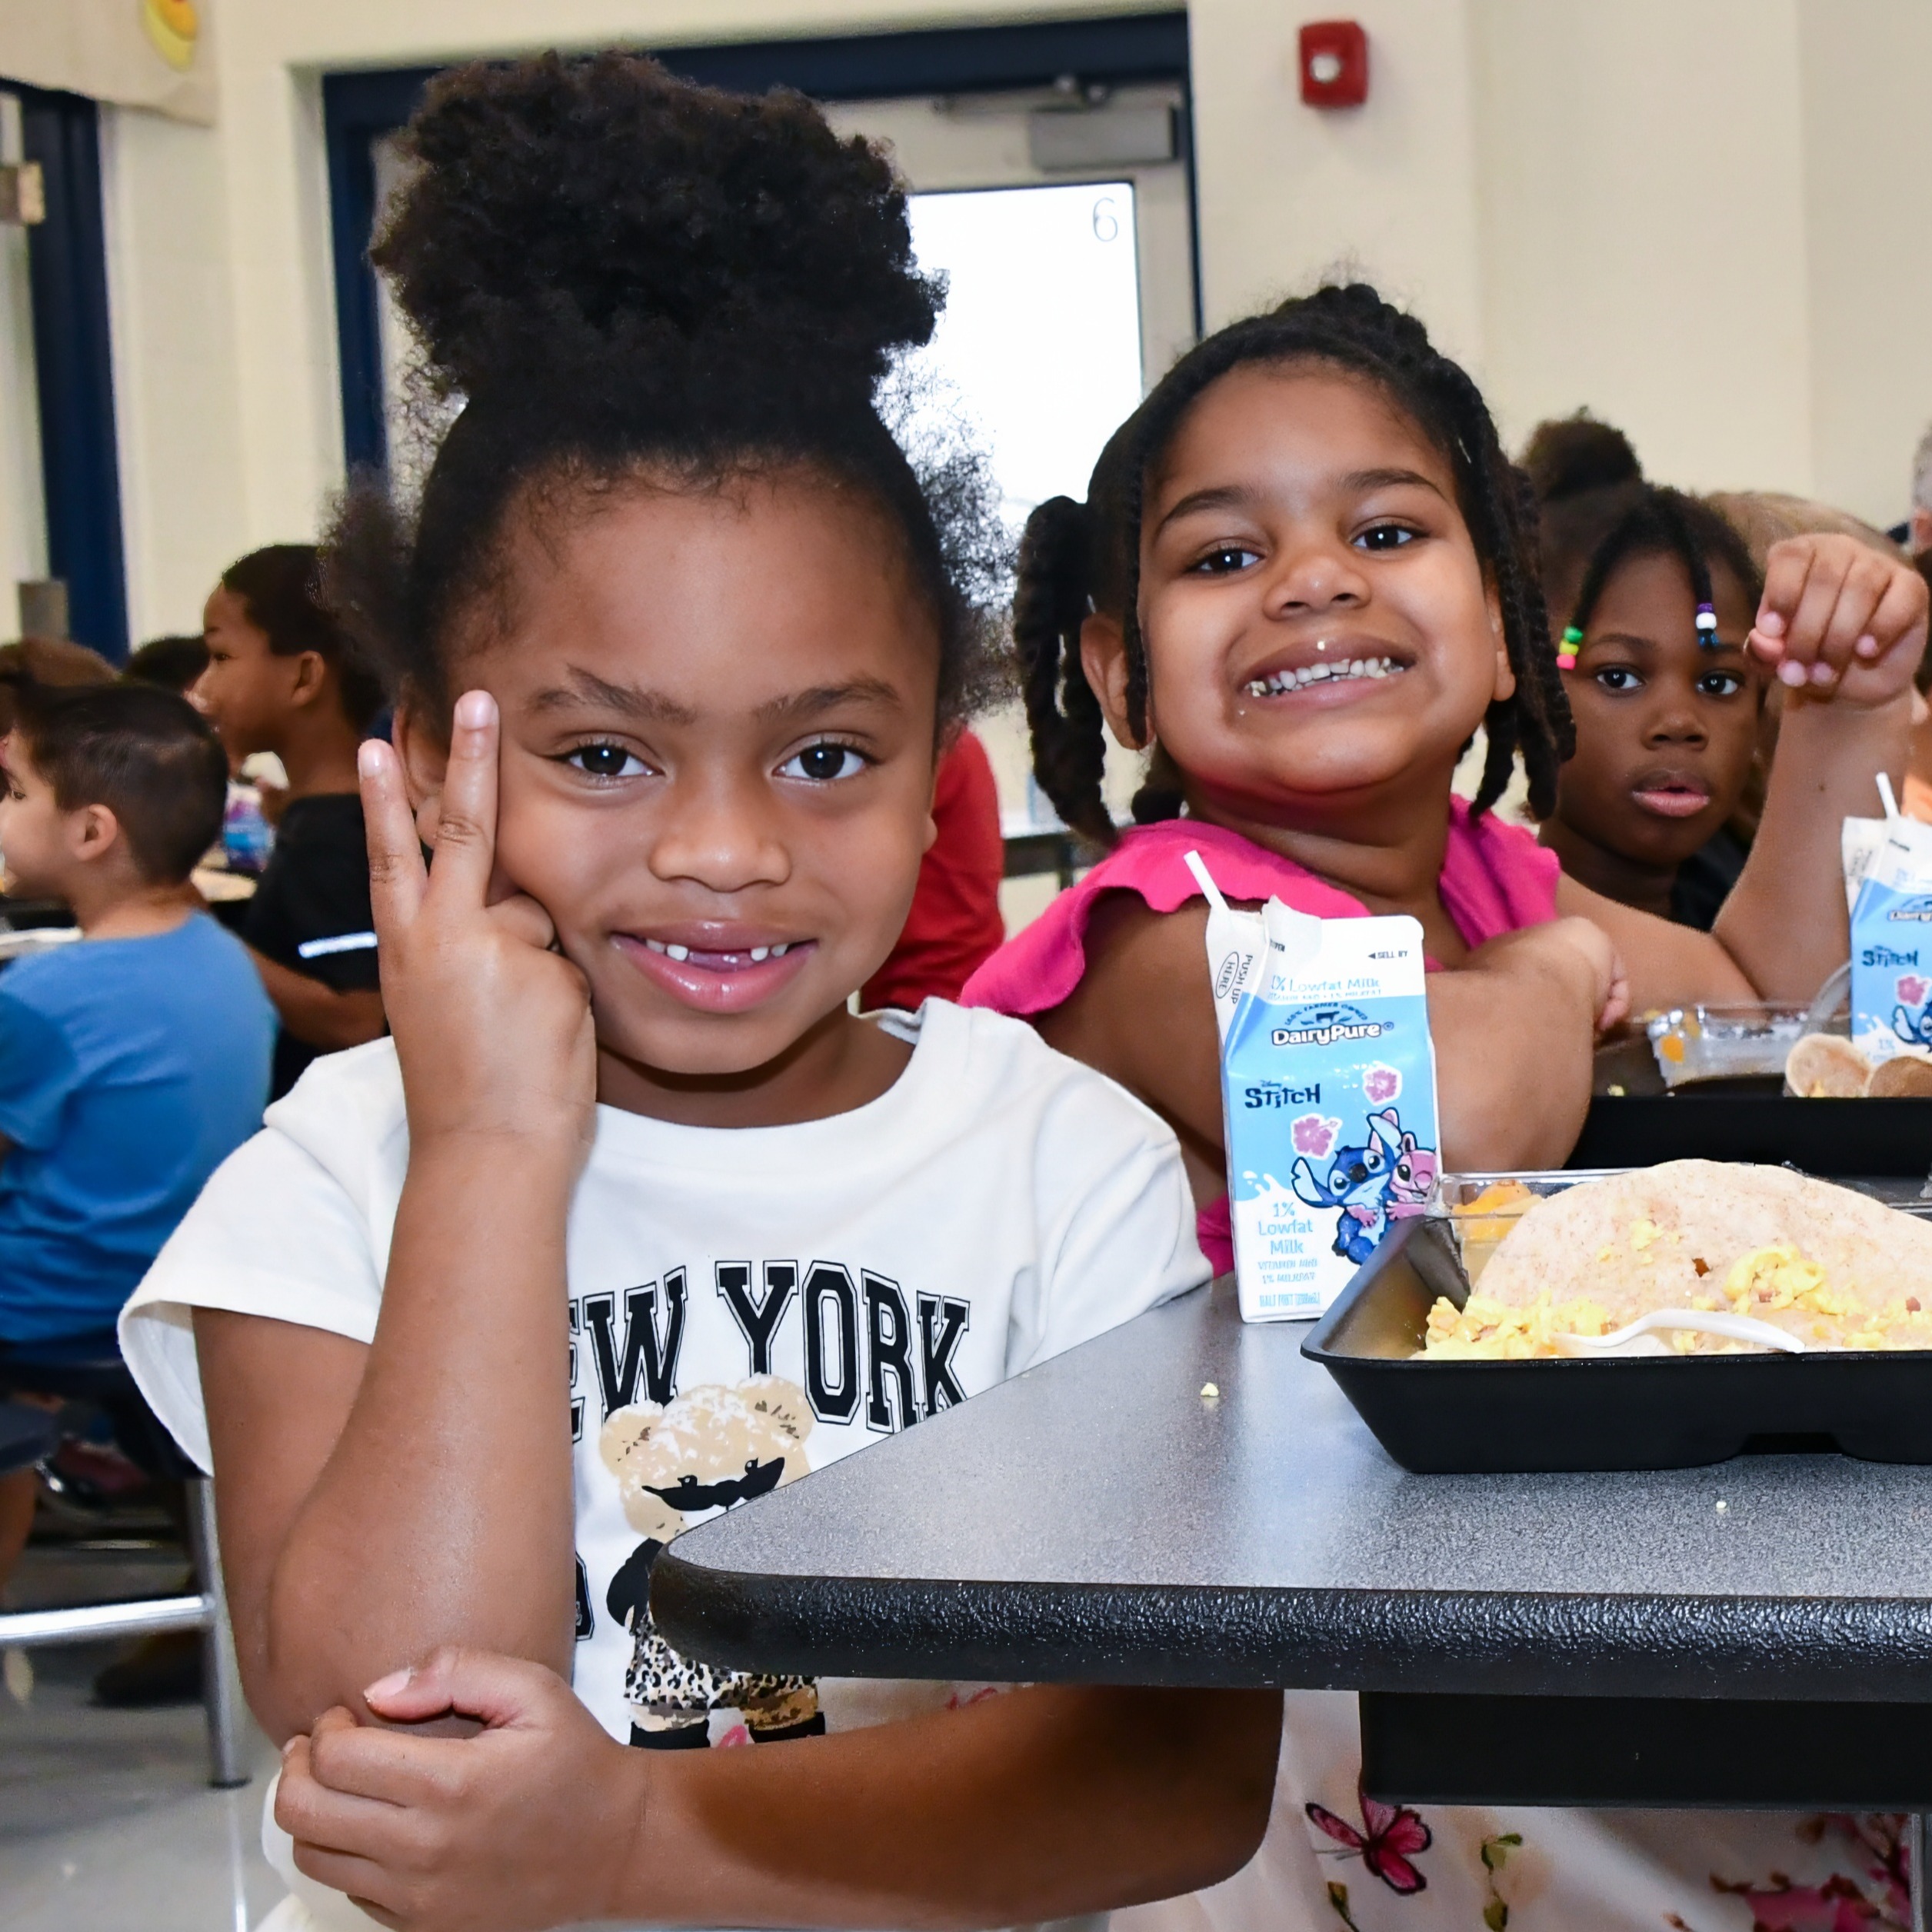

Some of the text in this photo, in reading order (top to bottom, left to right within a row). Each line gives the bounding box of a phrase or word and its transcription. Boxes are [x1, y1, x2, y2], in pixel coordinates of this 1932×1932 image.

[1092, 197, 1118, 242] 6
[1218, 961, 1235, 990] HERE
[1231, 954, 1253, 1004] PUSH UP
[1289, 978, 1343, 993] Lowfat
[1347, 978, 1380, 990] Milk
[1272, 1023, 1382, 1046] DairyPure
[1272, 1201, 1295, 1217] 1%
[1258, 1218, 1314, 1236] Lowfat
[1270, 1238, 1304, 1255] Milk
[715, 1259, 971, 1434] YORK
